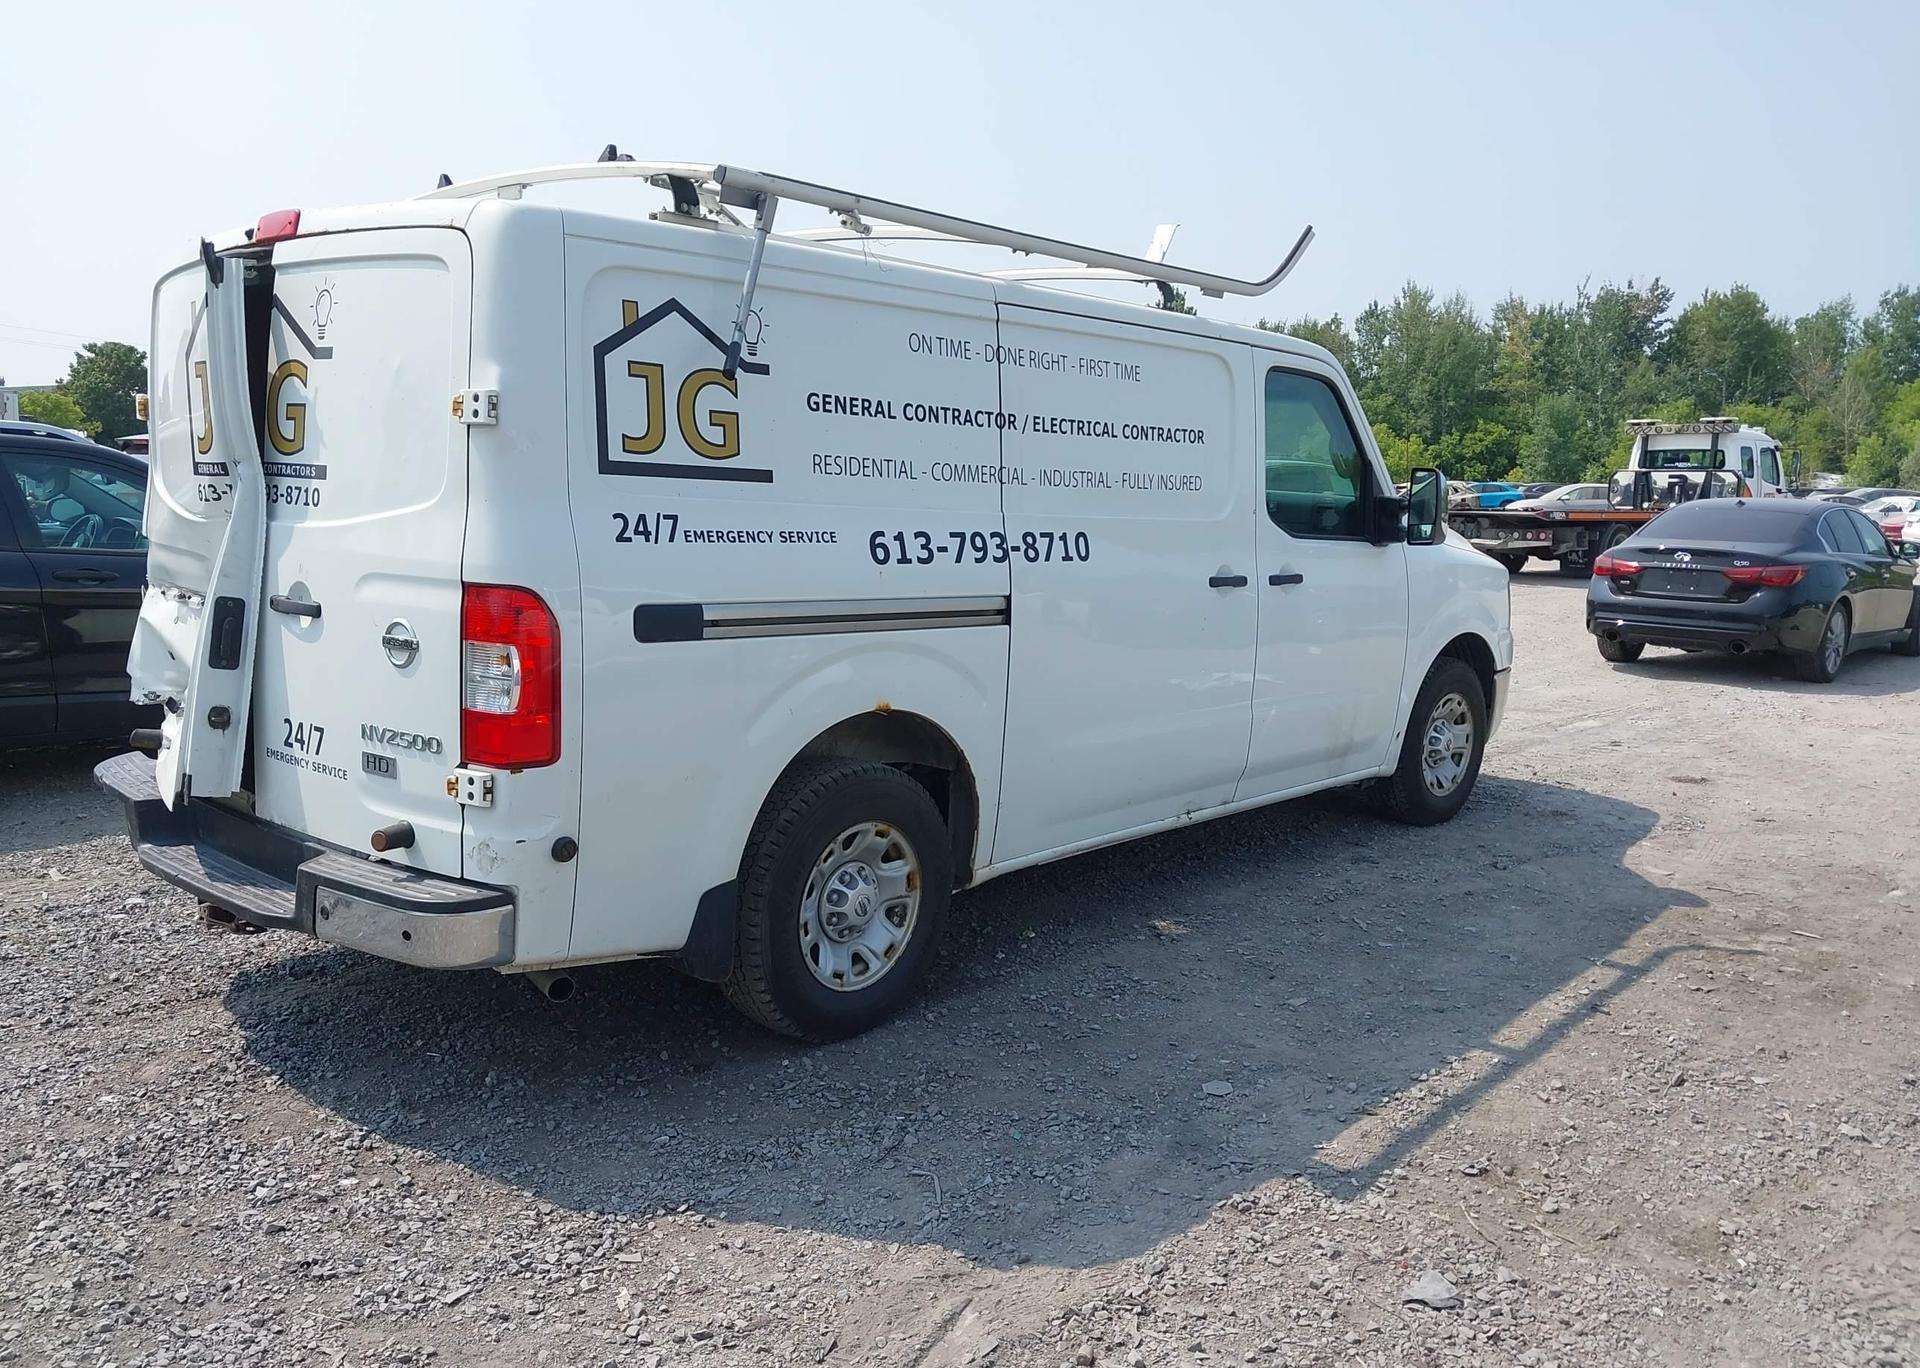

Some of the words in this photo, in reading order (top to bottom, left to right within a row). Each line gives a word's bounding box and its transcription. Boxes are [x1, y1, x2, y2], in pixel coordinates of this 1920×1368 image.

[908, 333, 934, 354] ON
[937, 337, 972, 361] TIME
[984, 344, 1026, 367] DONE
[1029, 353, 1068, 373] RIGHT
[1079, 358, 1111, 378] FIRST
[1114, 362, 1141, 382] TIME
[621, 360, 740, 460] JG
[806, 392, 897, 420] GENERAL
[902, 402, 1018, 430] CONTRACTOR
[1032, 416, 1118, 439] ELECTRICAL
[1122, 424, 1206, 445] CONTRACTOR
[198, 463, 225, 474] GENERAL
[264, 463, 316, 477] CONTRACTORS
[812, 454, 918, 480] RESIDENTIAL
[931, 462, 1028, 486] COMMERCIAL
[1039, 469, 1112, 489] INDUSTRIAL
[1121, 473, 1155, 490] FULLY
[1157, 474, 1203, 492] INSURED
[612, 512, 679, 544] 24/7
[683, 530, 774, 543] EMERGENCY
[779, 531, 838, 544] SERVICE
[869, 530, 1090, 565] 613-793-8710
[283, 717, 325, 755] 24/7
[361, 722, 443, 755] NV2500
[266, 747, 310, 769] EMERGENCY
[311, 761, 348, 781] SERVICE
[366, 754, 389, 773] HD
